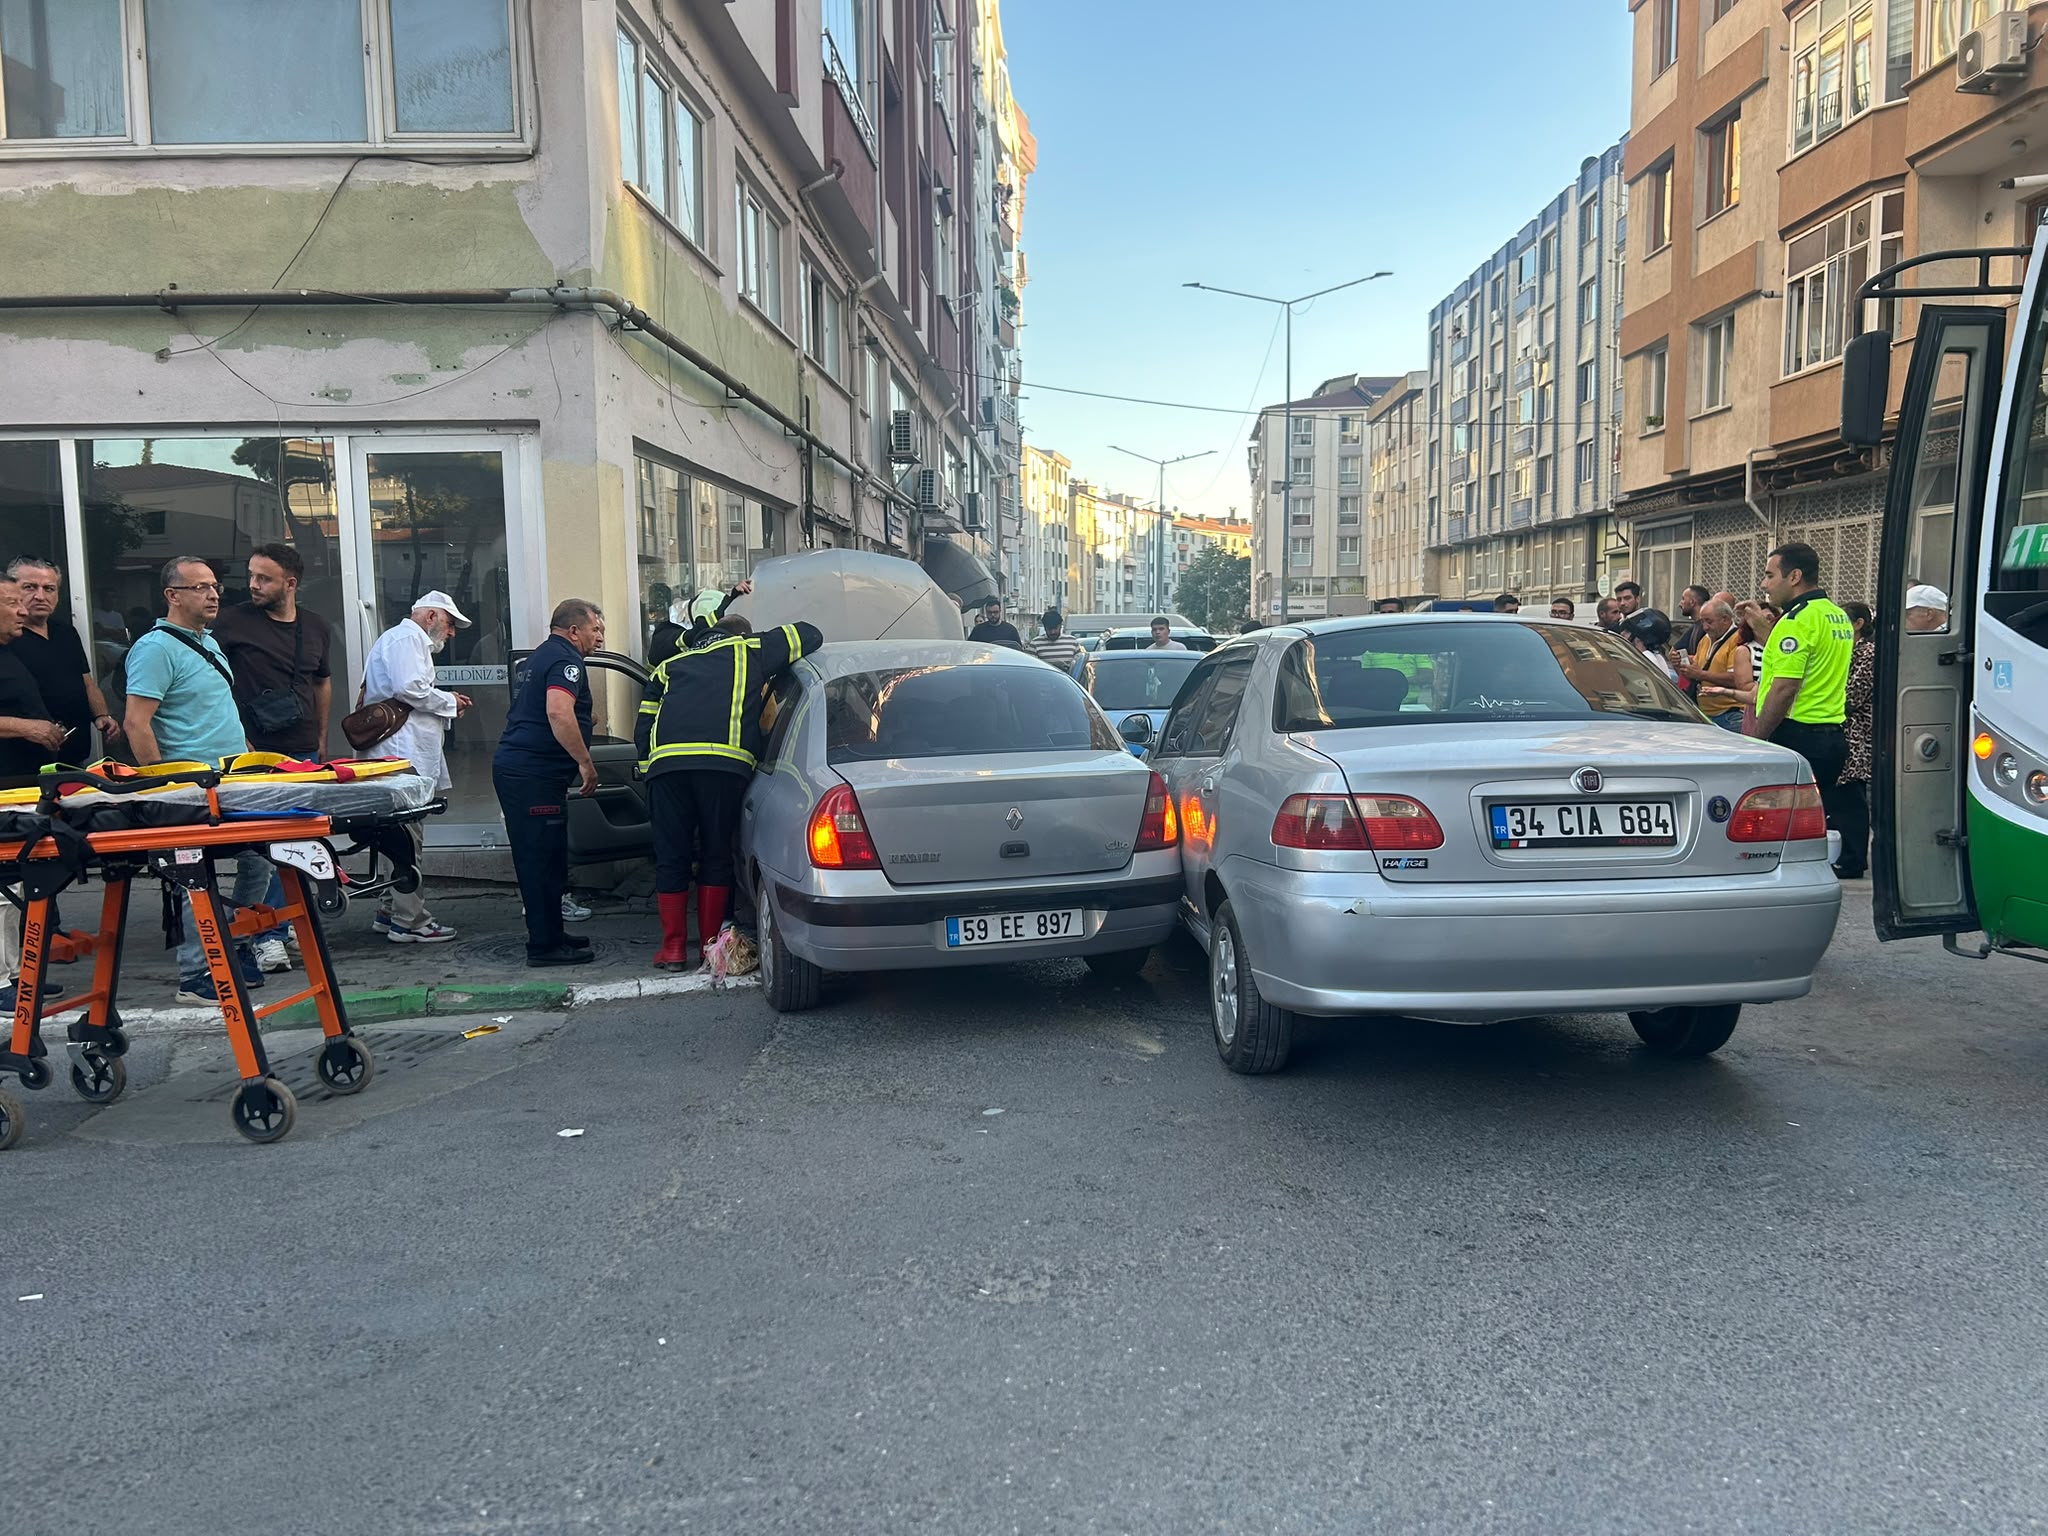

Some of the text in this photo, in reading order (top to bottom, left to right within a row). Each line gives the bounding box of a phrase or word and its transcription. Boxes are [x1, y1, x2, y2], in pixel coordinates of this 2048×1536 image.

[1583, 775, 1598, 787] FIAT
[1494, 805, 1669, 837] TR 34 CIA 684
[26, 920, 41, 949] PLUS
[198, 918, 217, 944] PLUS
[949, 912, 1072, 941] TR 59 EE 897
[20, 980, 33, 1002] TAY
[216, 979, 233, 1002] TAY
